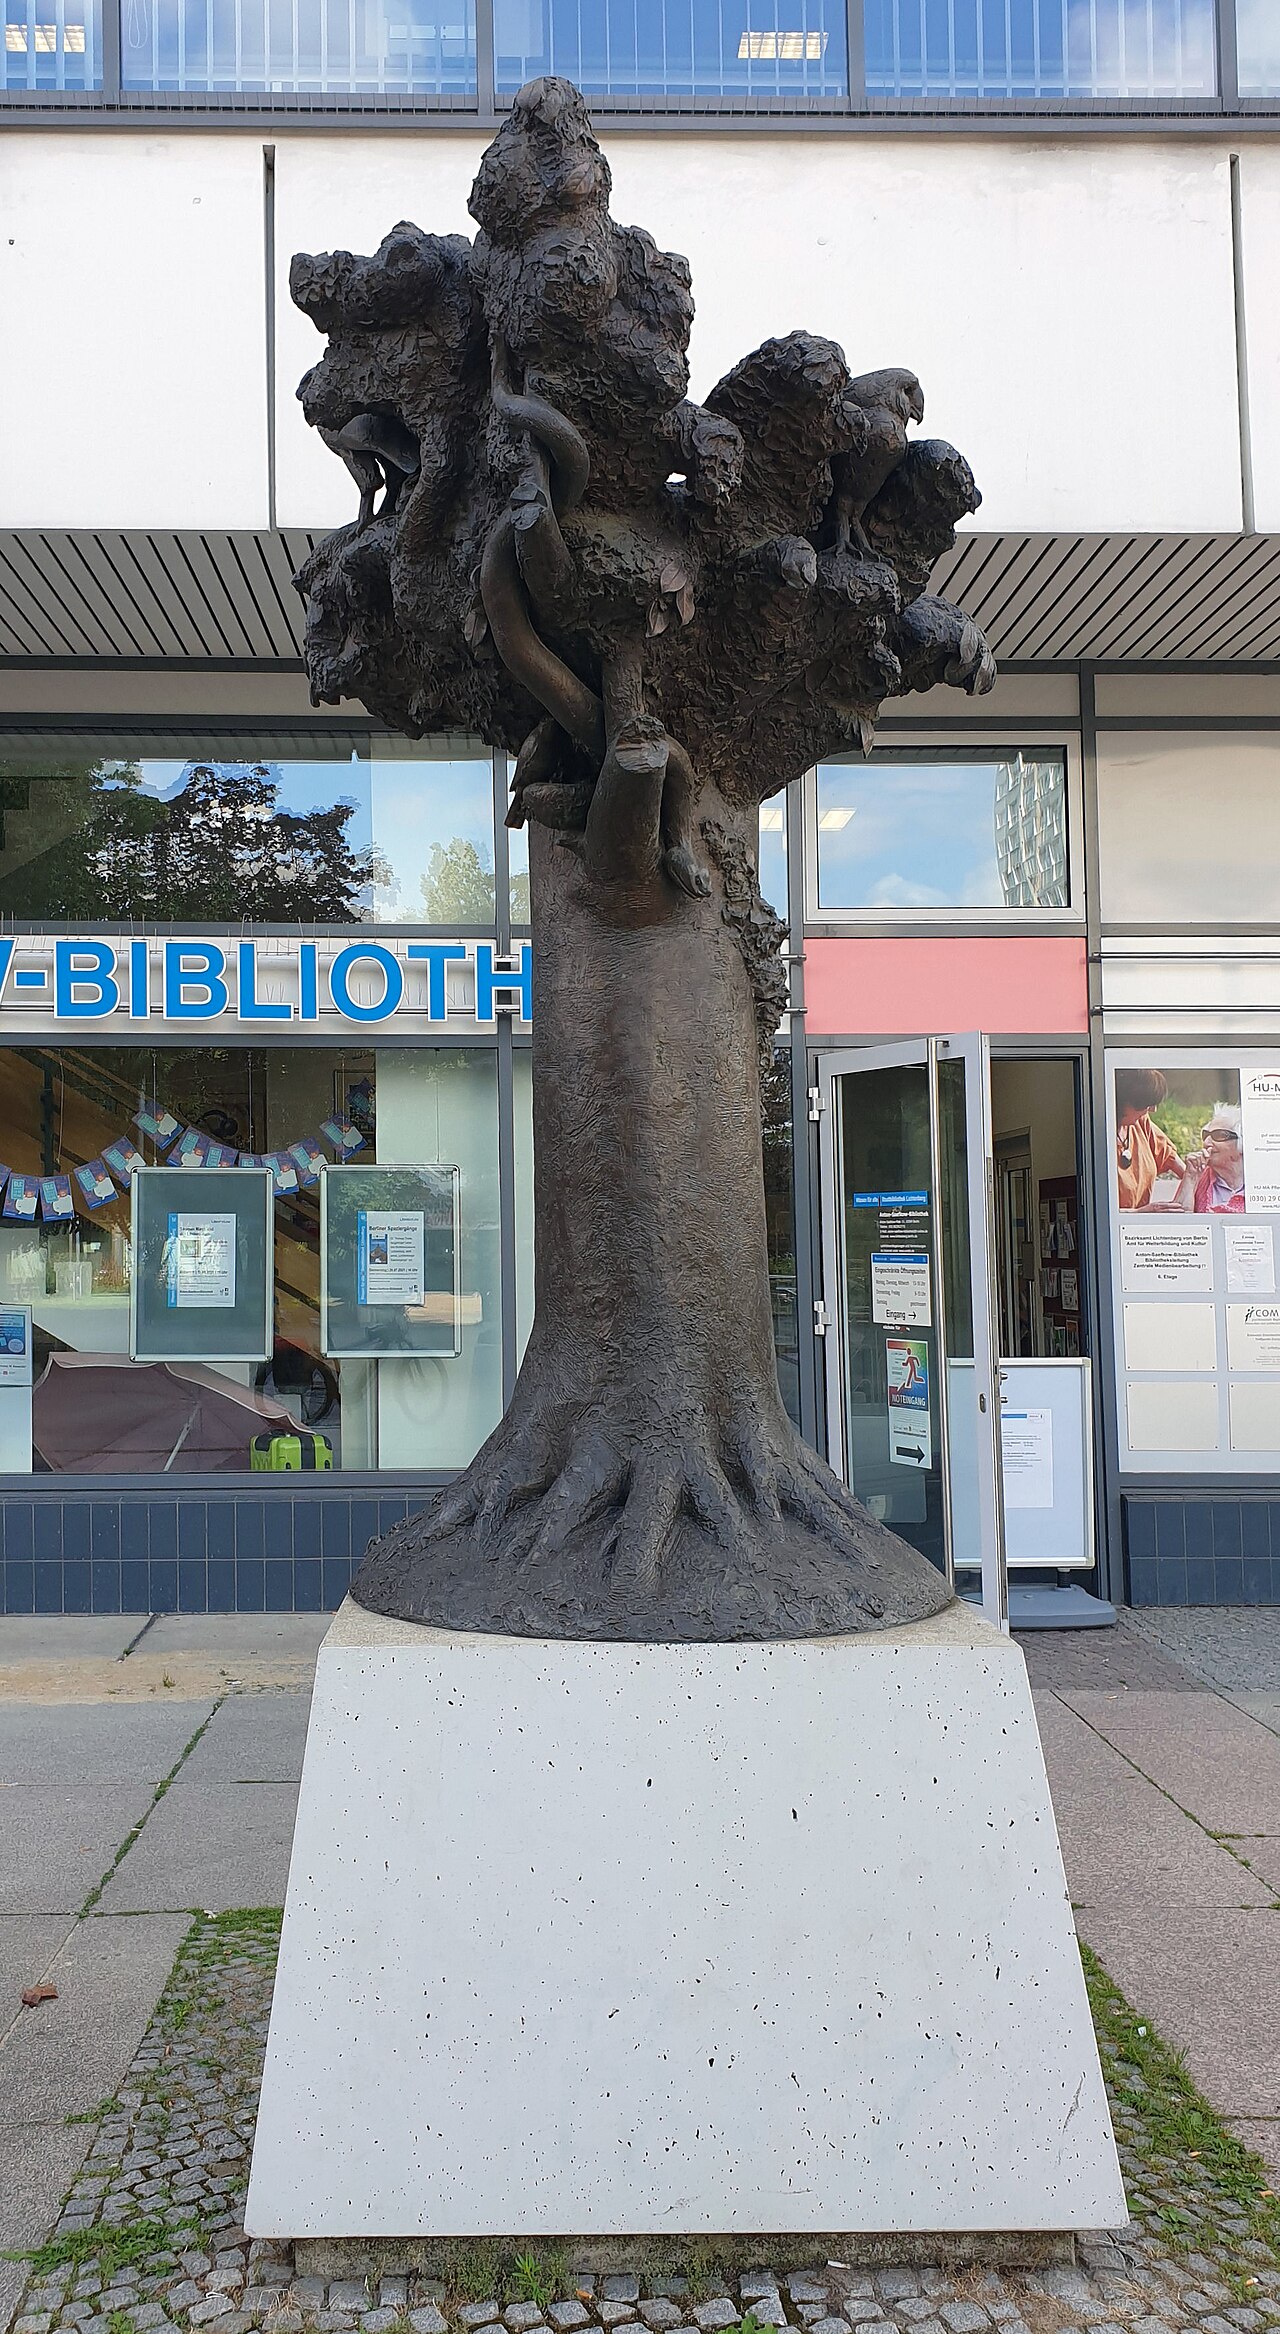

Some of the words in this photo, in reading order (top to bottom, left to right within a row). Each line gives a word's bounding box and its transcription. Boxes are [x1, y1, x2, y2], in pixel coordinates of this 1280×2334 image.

[0, 938, 532, 1023] -BIBLIOTH
[885, 1308, 906, 1321] Eingang
[892, 1394, 926, 1407] NOTEINGANG
